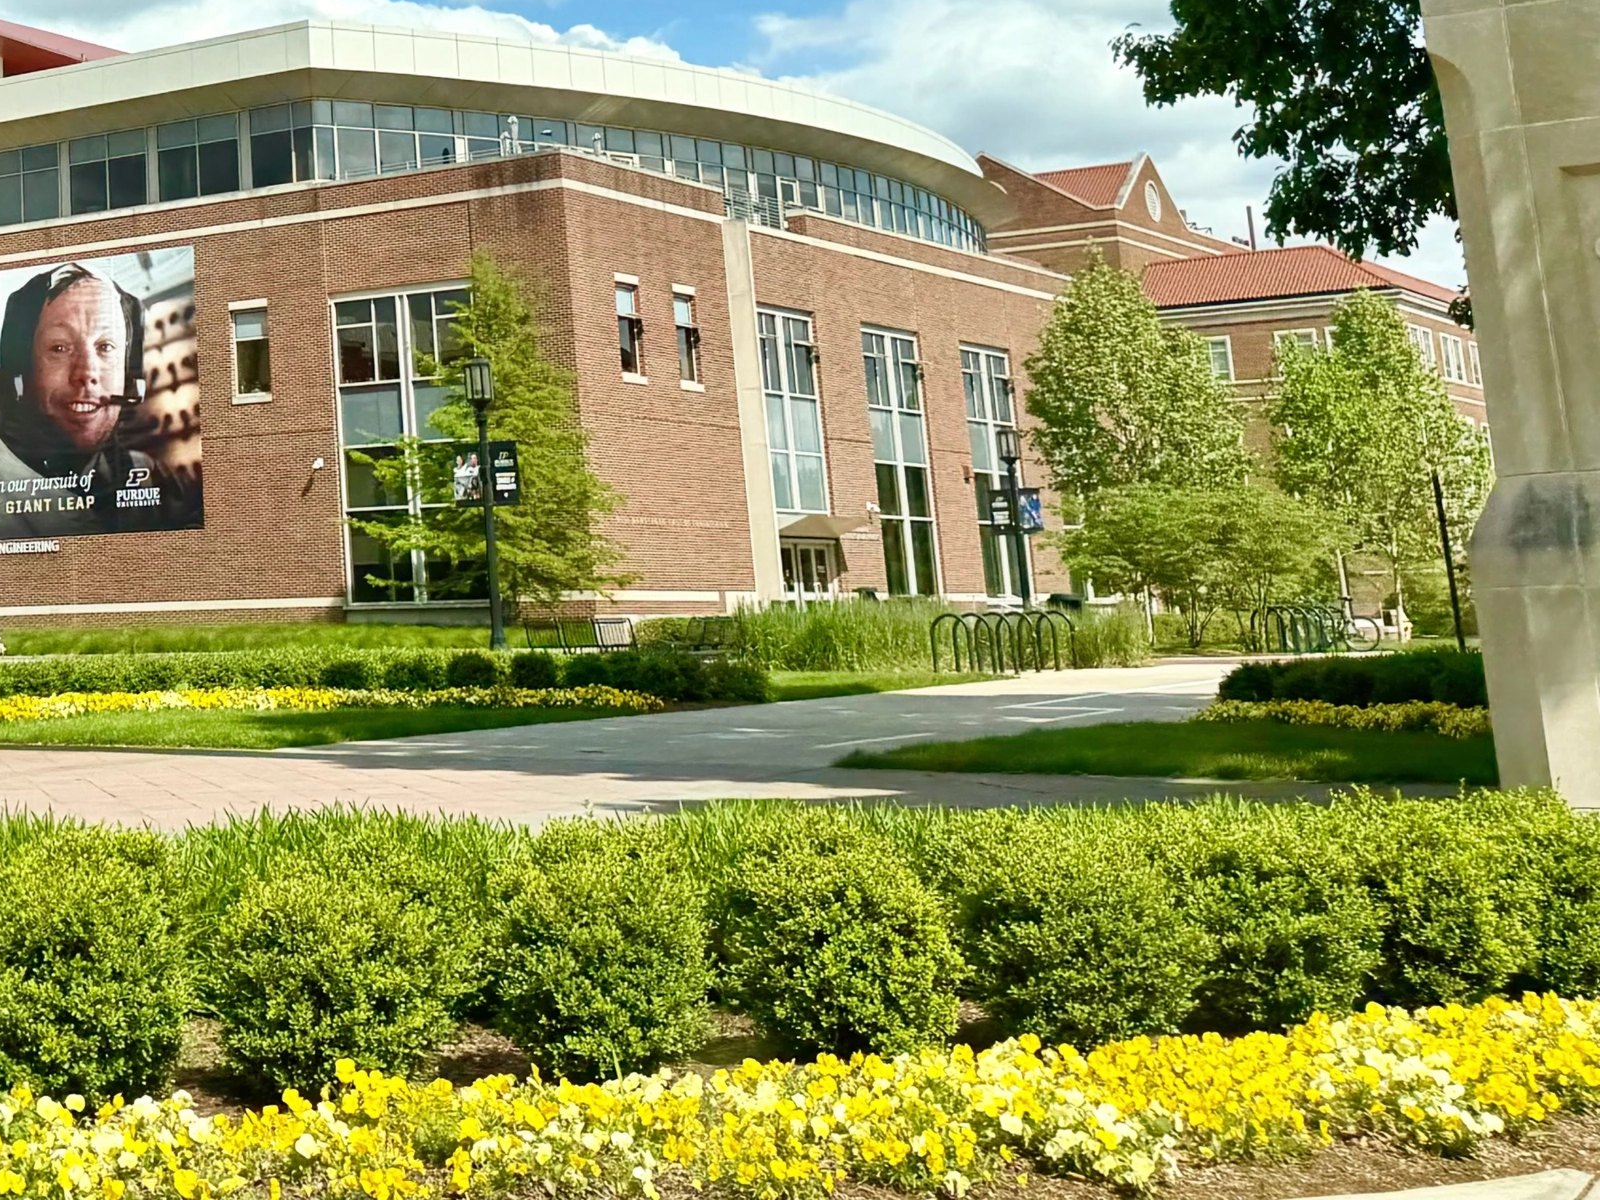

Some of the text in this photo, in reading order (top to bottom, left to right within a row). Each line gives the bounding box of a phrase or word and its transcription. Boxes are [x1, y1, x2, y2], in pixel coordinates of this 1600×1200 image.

[7, 479, 31, 493] our
[31, 470, 78, 496] pursuit
[79, 469, 96, 492] of
[125, 468, 151, 487] P
[116, 487, 161, 502] PURDUE
[5, 498, 52, 515] GIANT
[57, 495, 95, 511] LEAP
